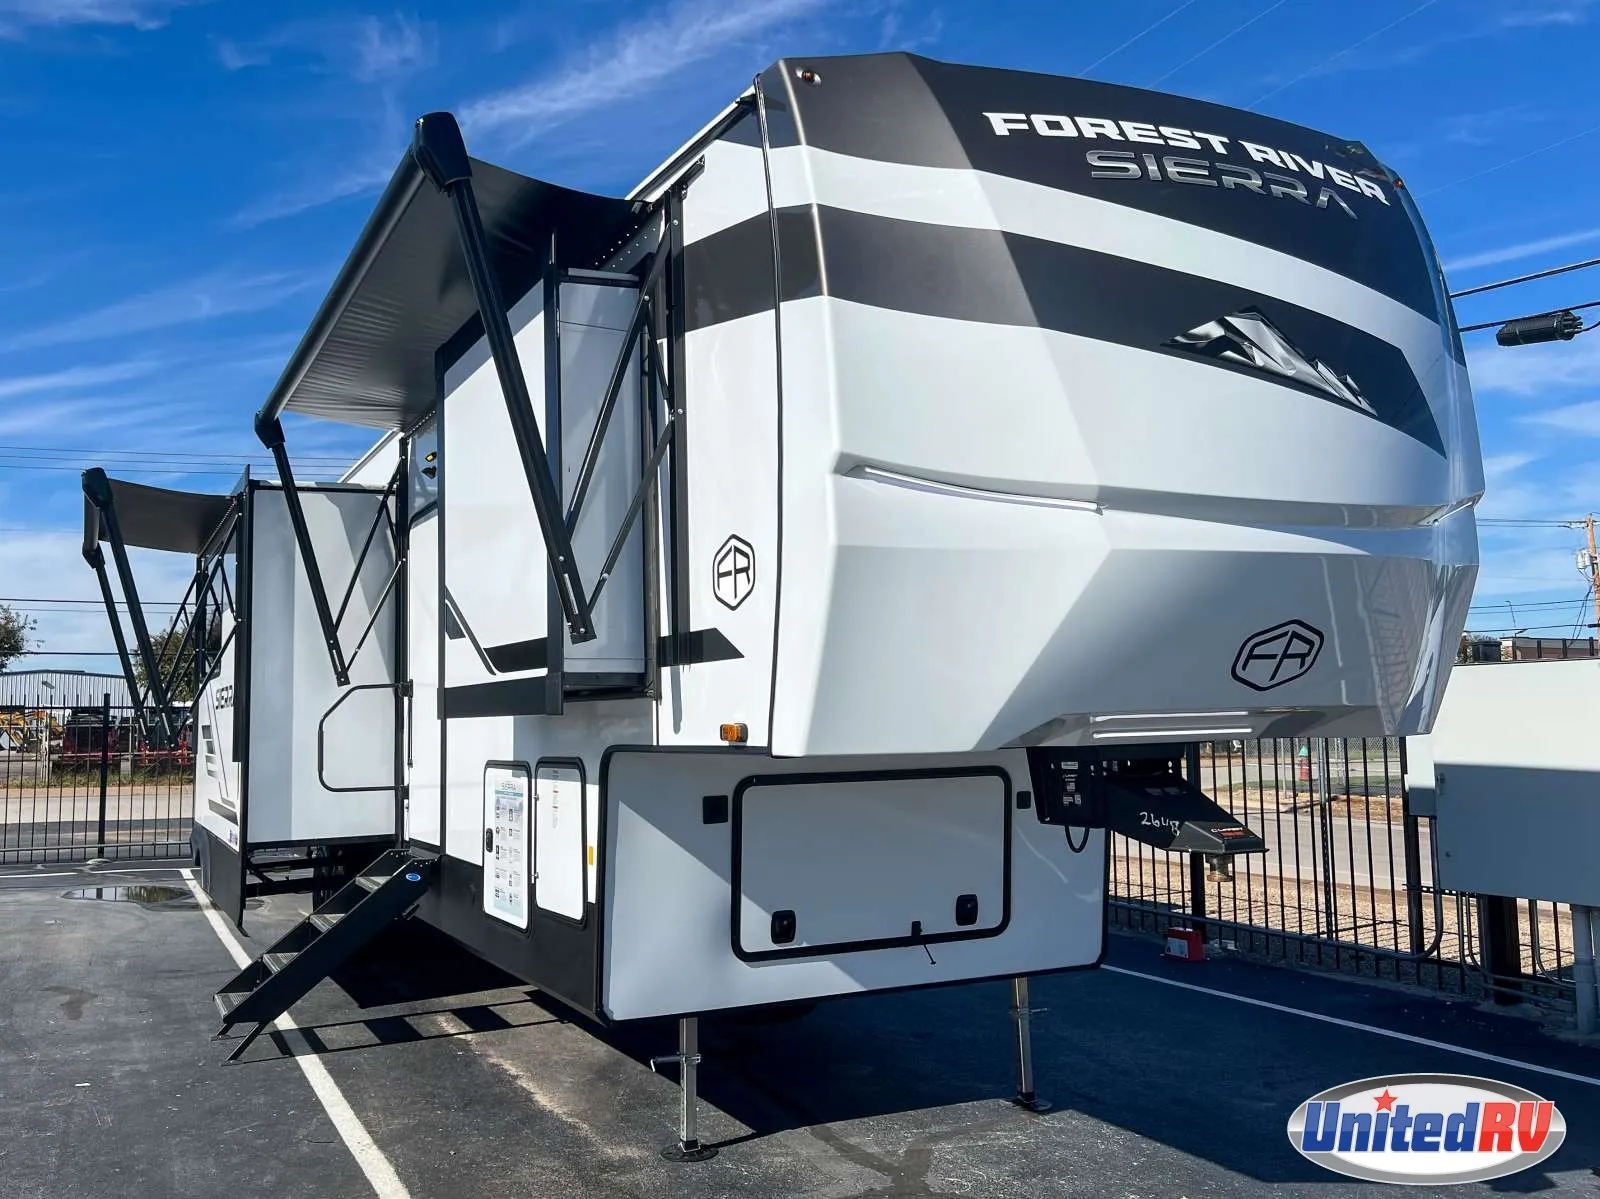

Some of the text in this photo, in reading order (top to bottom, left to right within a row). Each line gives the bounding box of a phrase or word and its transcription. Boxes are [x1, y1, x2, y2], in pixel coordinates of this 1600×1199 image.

[982, 112, 1391, 207] FOREST RIVER
[1086, 150, 1359, 220] SIERRA
[215, 685, 234, 710] SIERR
